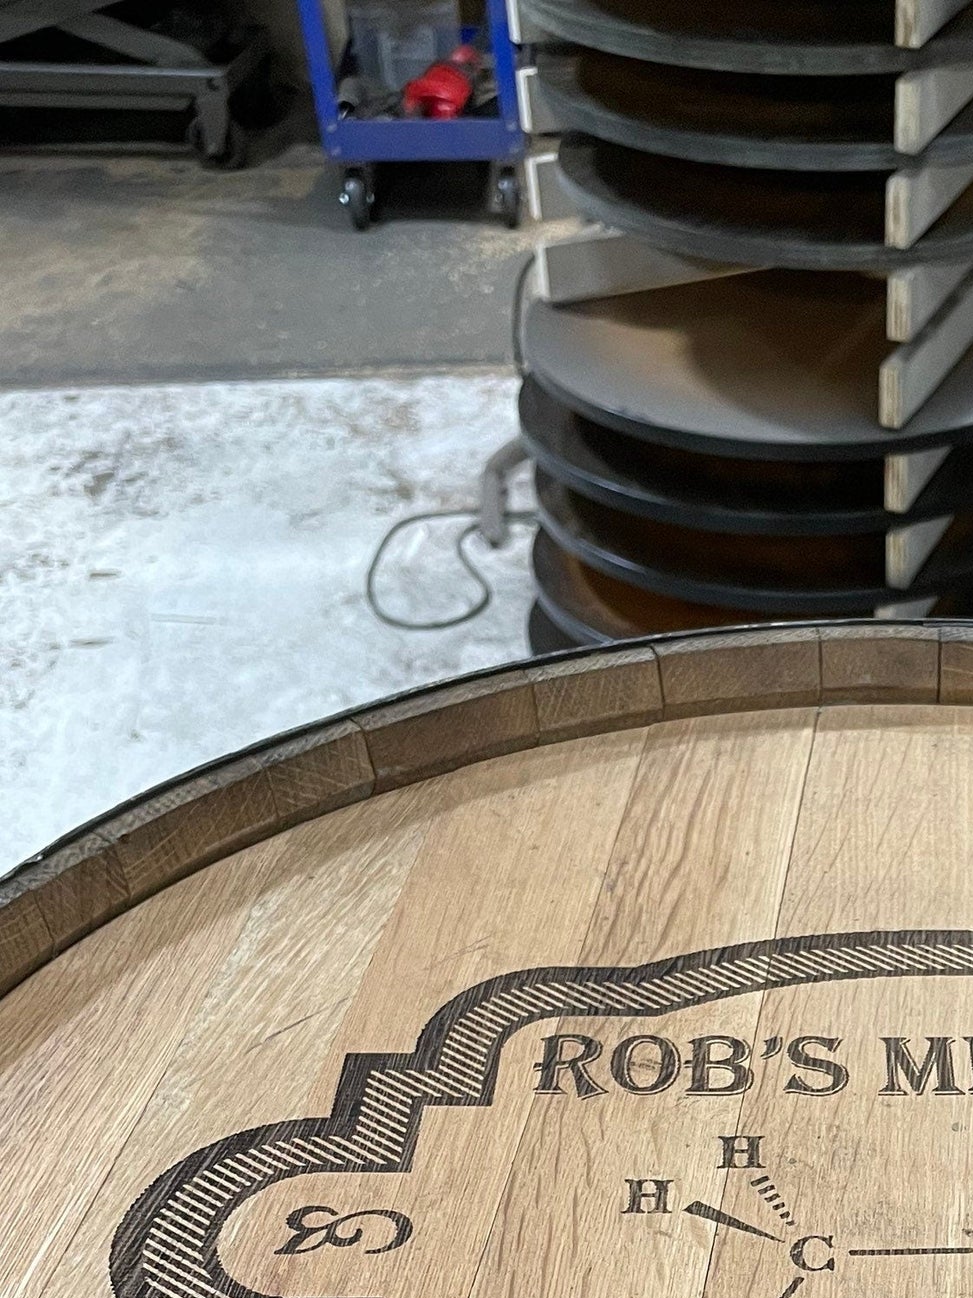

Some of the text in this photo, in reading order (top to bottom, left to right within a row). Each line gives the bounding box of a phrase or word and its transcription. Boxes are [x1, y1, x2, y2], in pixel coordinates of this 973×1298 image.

[533, 1034, 849, 1099] ROB'S
[717, 1135, 766, 1169] H
[621, 1178, 674, 1214] H
[789, 1235, 835, 1272] C
